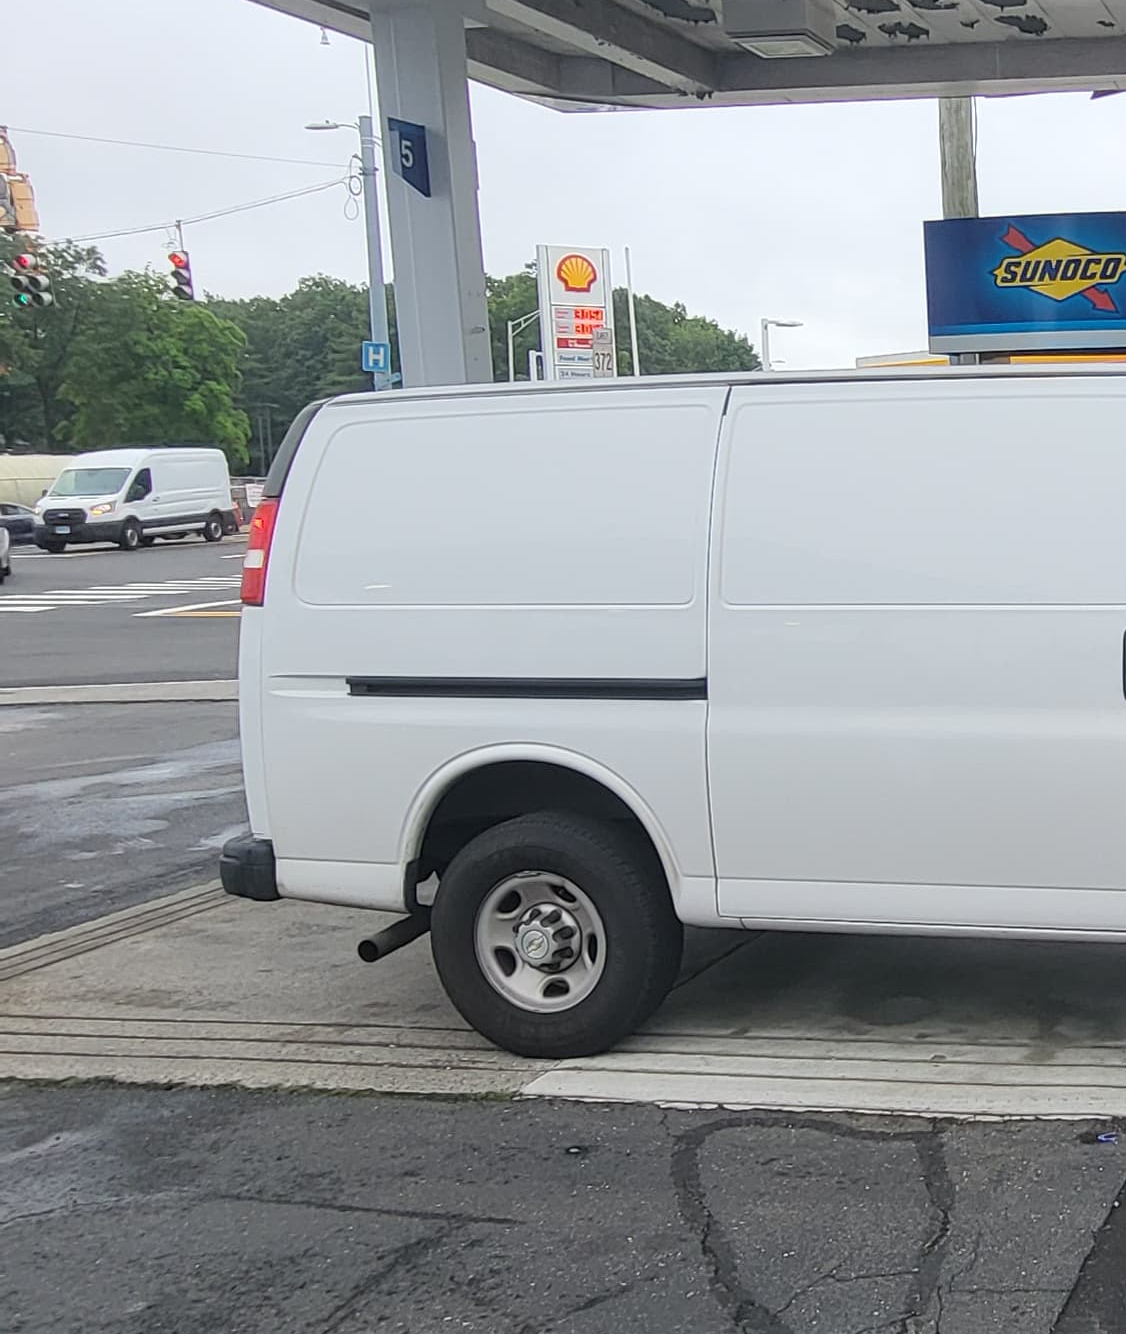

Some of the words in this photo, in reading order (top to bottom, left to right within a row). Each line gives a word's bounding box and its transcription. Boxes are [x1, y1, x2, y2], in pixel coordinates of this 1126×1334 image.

[401, 139, 414, 168] 5
[1001, 257, 1122, 283] SUNOCO
[368, 346, 384, 368] H
[595, 352, 613, 371] 372
